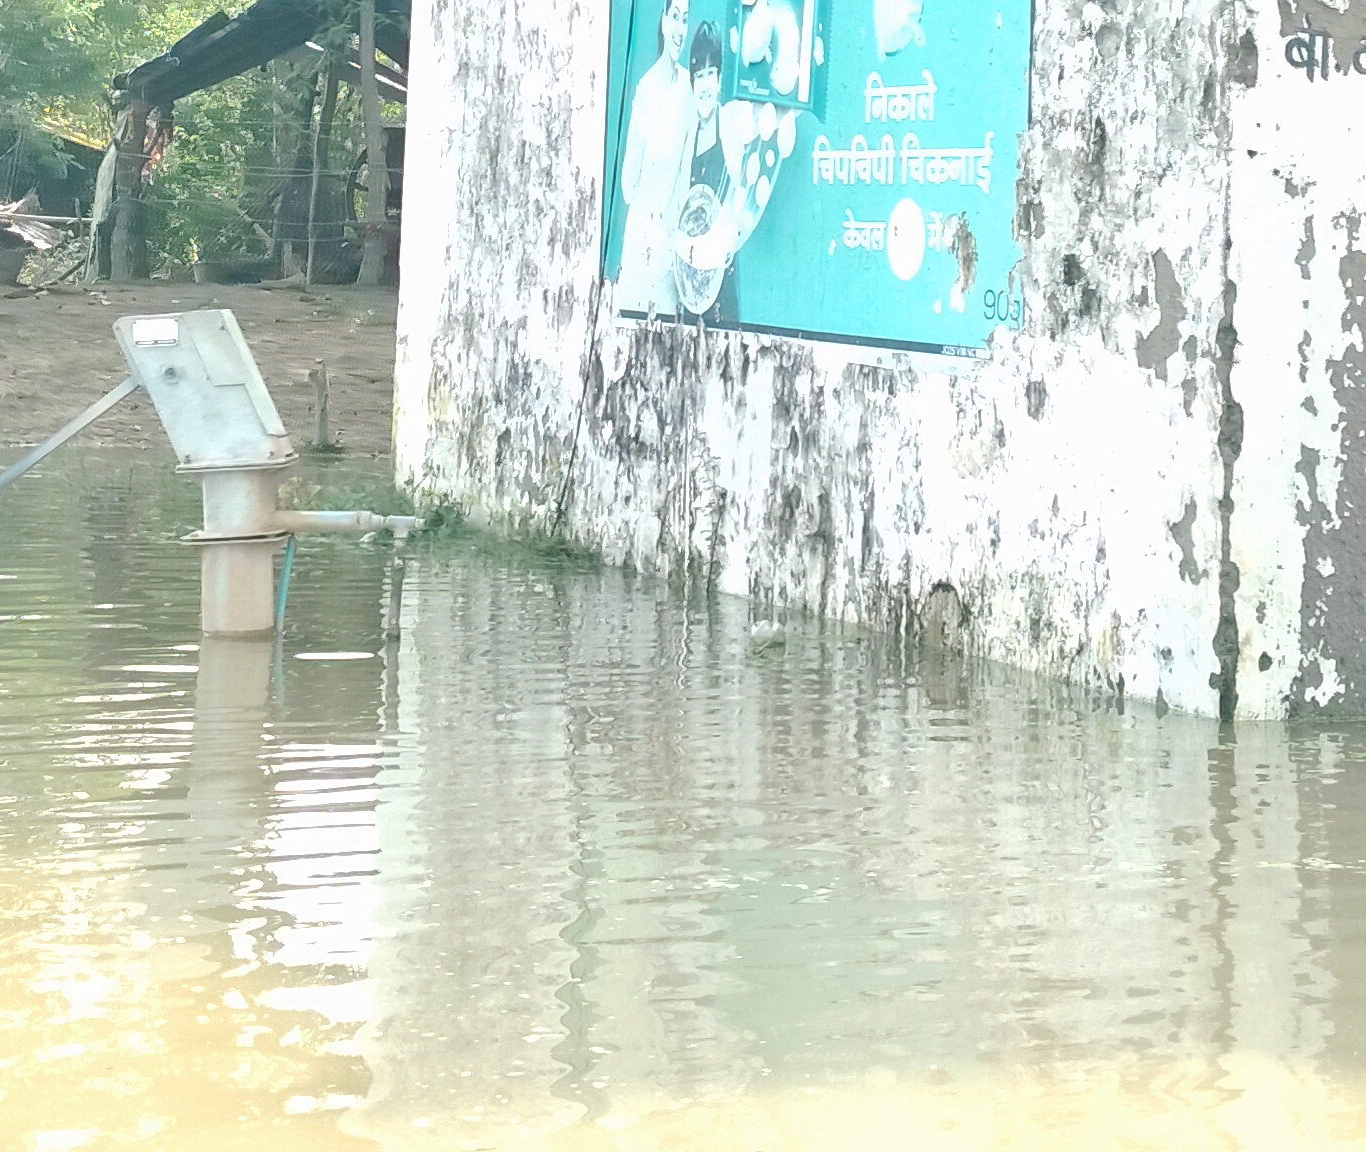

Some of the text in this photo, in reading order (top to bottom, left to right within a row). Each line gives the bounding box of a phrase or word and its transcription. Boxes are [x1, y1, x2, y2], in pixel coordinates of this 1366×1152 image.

[864, 68, 938, 124] निकाले
[812, 130, 996, 196] चिपचिपी चिकनाई
[842, 207, 887, 251] केवल
